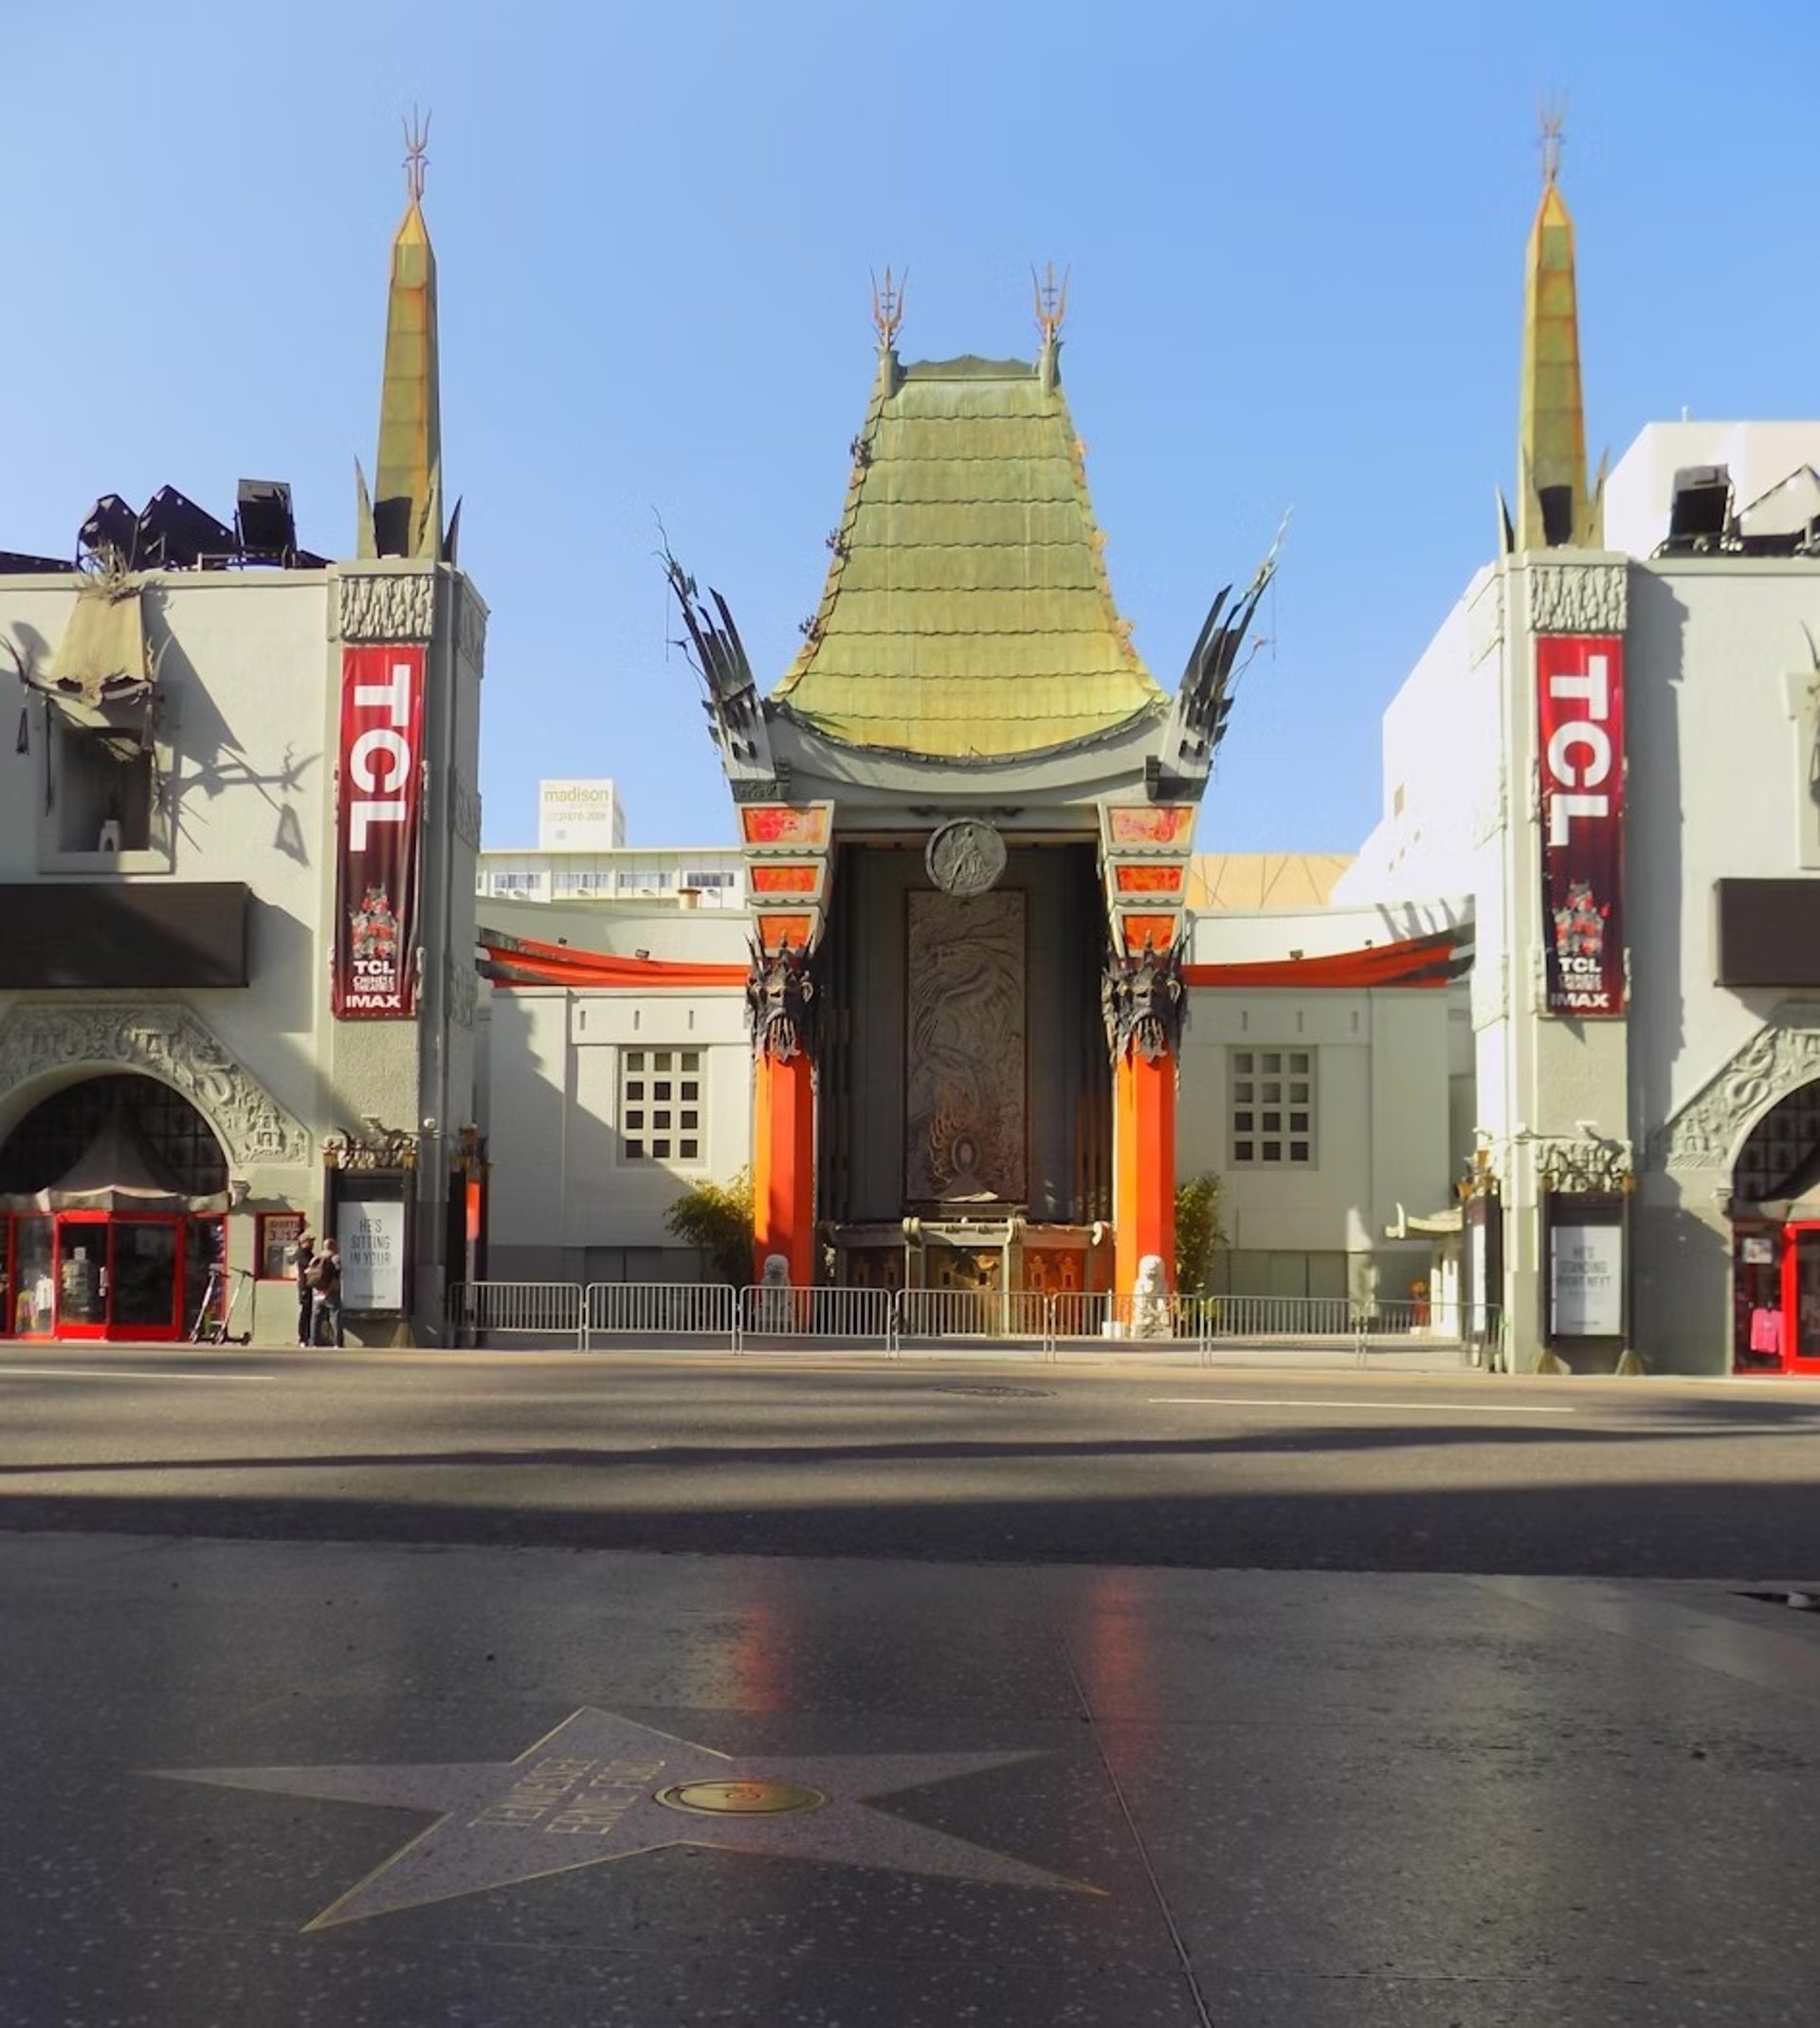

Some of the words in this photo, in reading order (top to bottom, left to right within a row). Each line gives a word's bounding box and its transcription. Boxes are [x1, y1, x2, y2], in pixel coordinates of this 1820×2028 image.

[349, 665, 411, 851] TCL
[1547, 655, 1611, 846] TCL
[544, 787, 609, 801] madison
[353, 959, 395, 975] TCL
[1558, 957, 1603, 973] TCL
[346, 995, 401, 1008] IMAX
[1551, 993, 1610, 1008] IMAX
[359, 1219, 382, 1233] HE'S
[350, 1235, 391, 1250] SITTING
[350, 1252, 361, 1264] IN
[364, 1252, 391, 1265] YOUR
